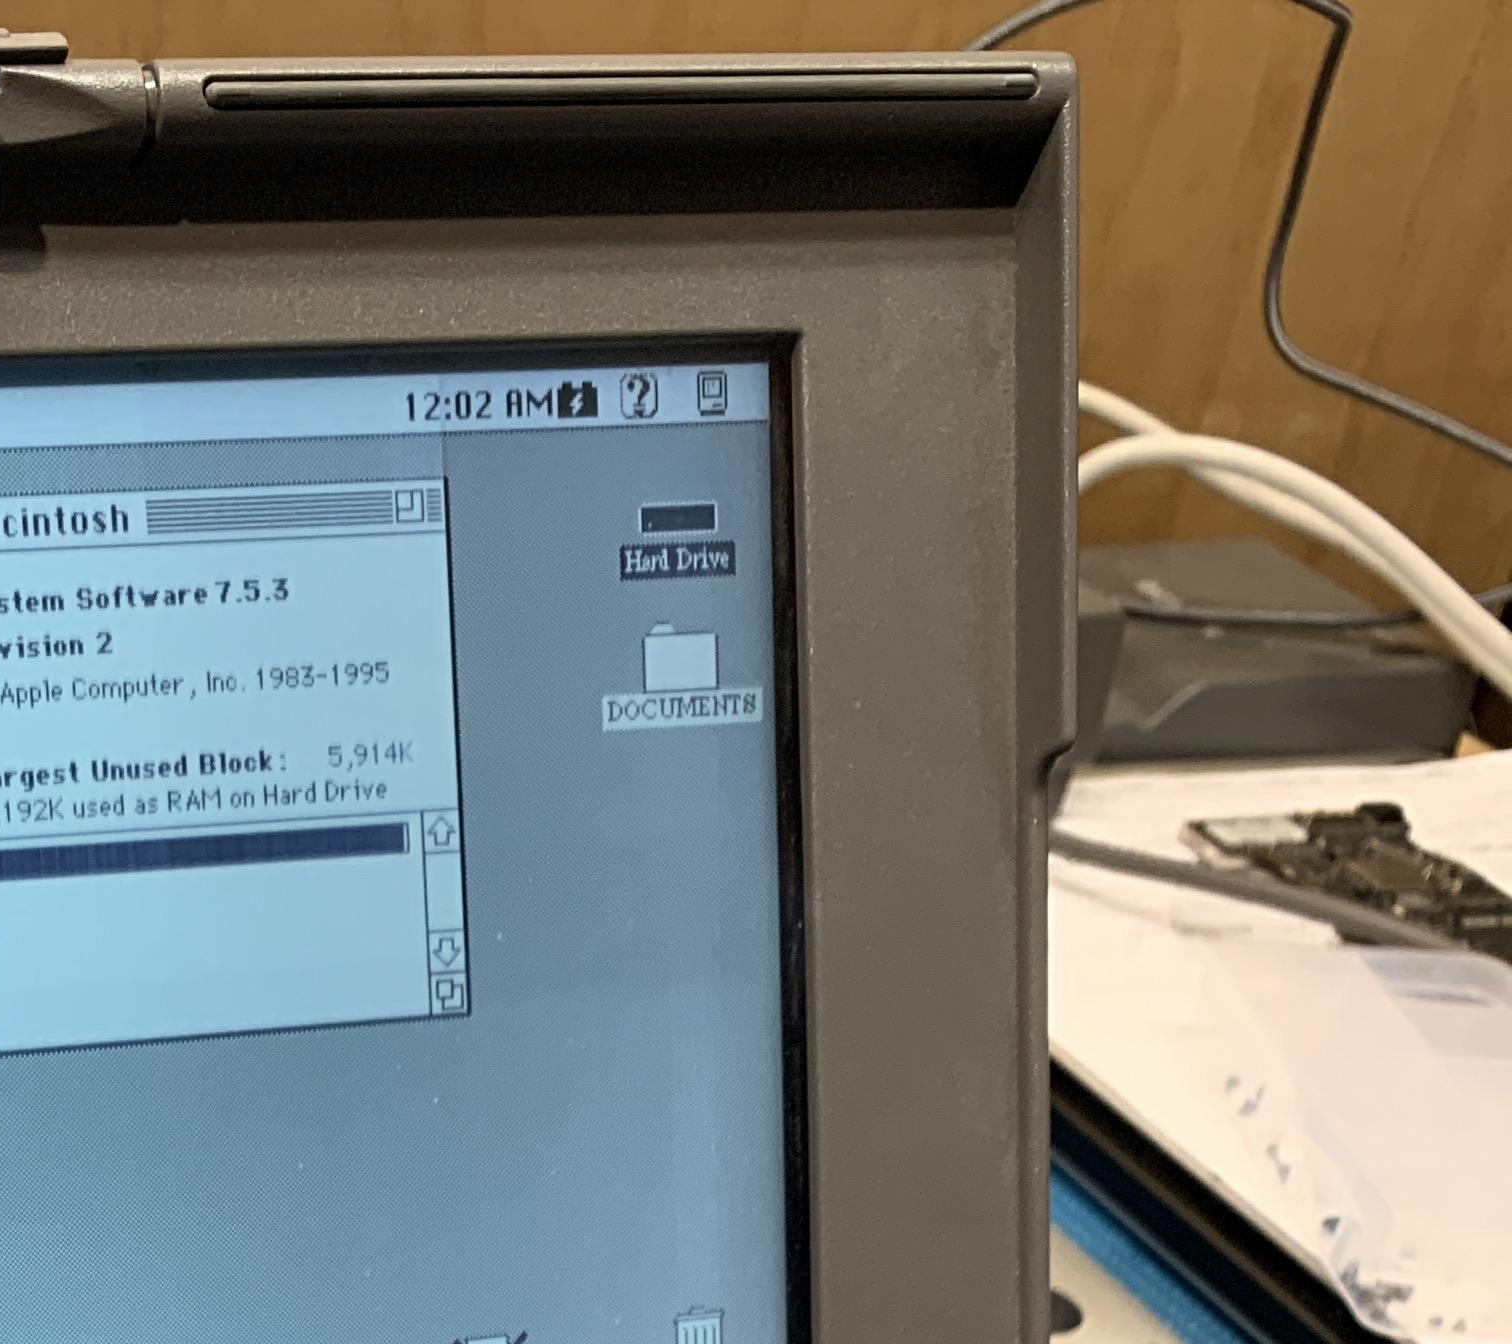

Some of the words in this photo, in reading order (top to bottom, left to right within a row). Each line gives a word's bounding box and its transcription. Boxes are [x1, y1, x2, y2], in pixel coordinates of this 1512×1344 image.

[406, 390, 492, 423] 12:02
[506, 388, 553, 417] AM
[624, 549, 671, 573] Hard
[676, 546, 731, 571] Drive
[77, 585, 208, 609] Software
[214, 578, 289, 603] 7.5.3
[96, 631, 113, 655] 2
[0, 676, 62, 709] Apple
[72, 672, 197, 702] Computer,
[207, 670, 246, 693] Inc.
[257, 661, 390, 691] 1983-1995
[608, 693, 757, 722] DOCUMENTS
[91, 754, 188, 782] Unused
[327, 740, 415, 773] 5,914K
[73, 795, 125, 818] used
[134, 794, 158, 814] as
[167, 788, 222, 813] RAM
[229, 789, 252, 808] on
[263, 779, 317, 806] Hard
[325, 779, 388, 802] Drive
